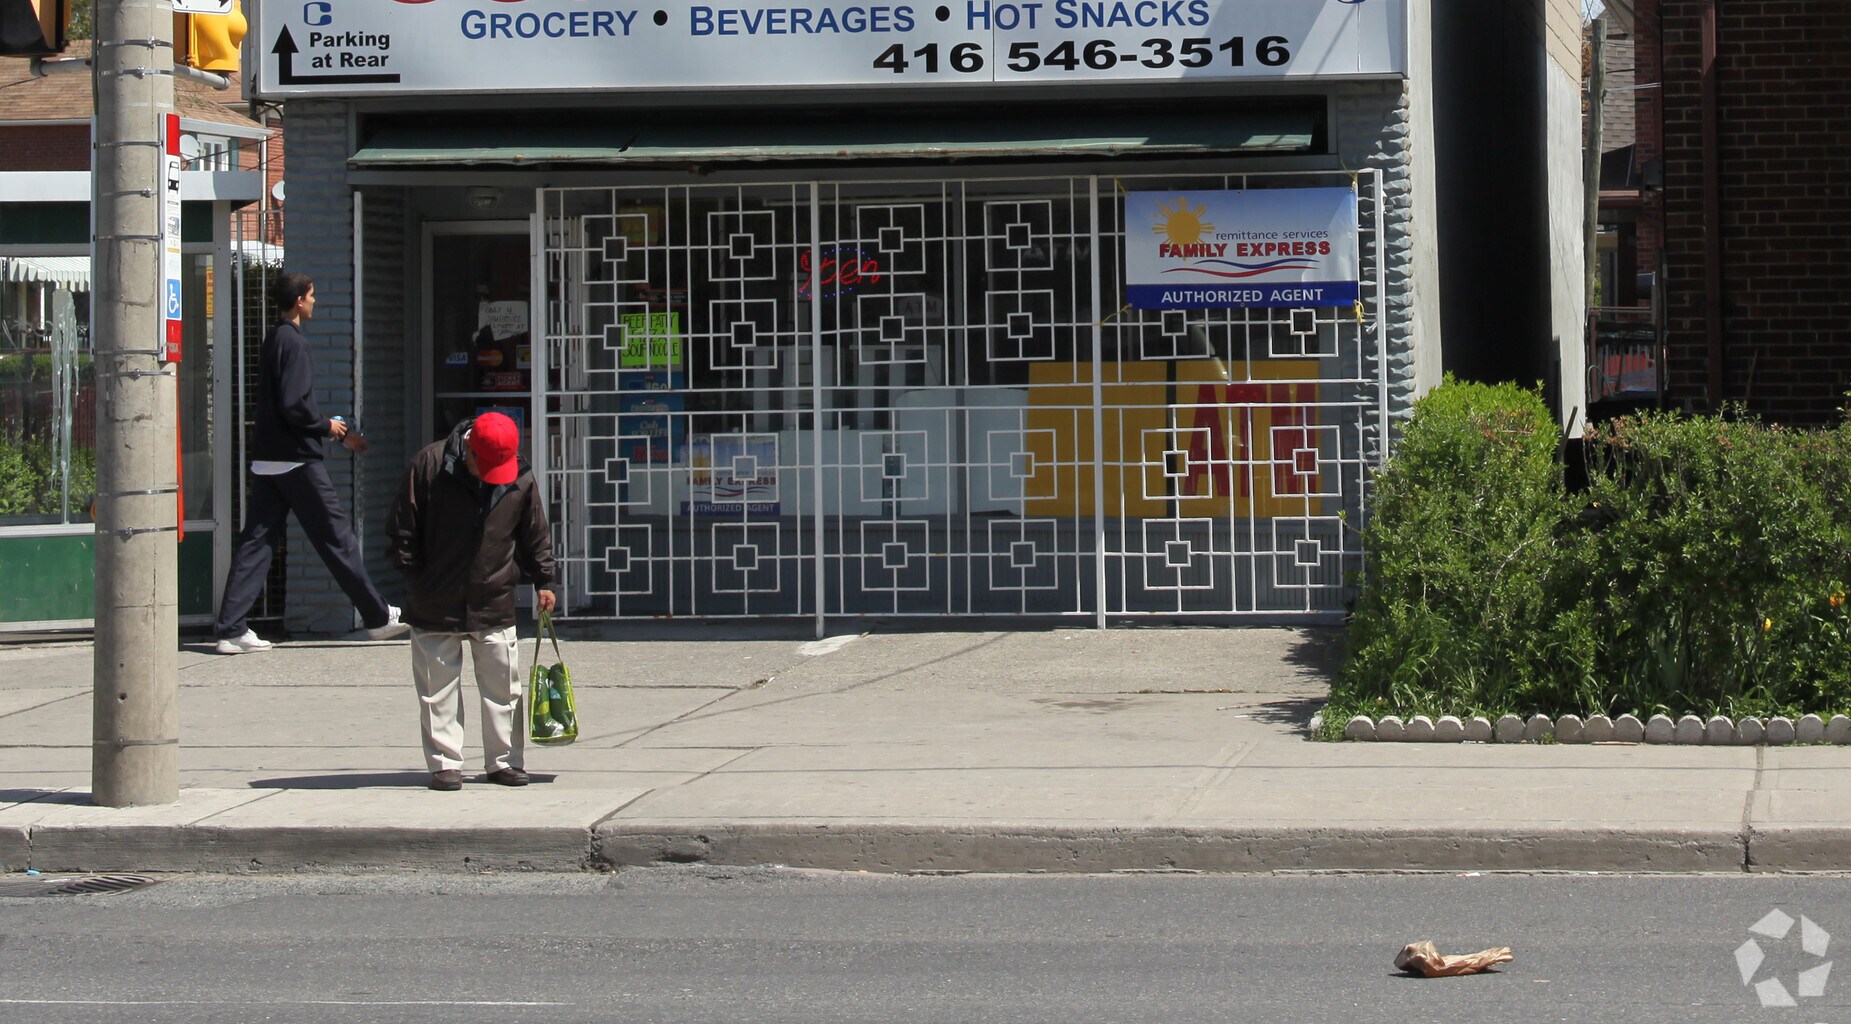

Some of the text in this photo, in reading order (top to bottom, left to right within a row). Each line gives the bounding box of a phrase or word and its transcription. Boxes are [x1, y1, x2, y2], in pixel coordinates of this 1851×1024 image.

[460, 8, 639, 40] GROCERY
[689, 4, 916, 37] BEVERAGES
[966, 0, 1042, 31] HOT
[309, 31, 391, 50] Parking
[311, 51, 389, 68] at Rear
[872, 35, 1291, 75] 416 546-3516
[1216, 228, 1329, 240] remittance services
[1159, 240, 1331, 258] FAMILY EXPRESS
[1161, 288, 1323, 303] AUTHORIZED AGENT
[1183, 383, 1318, 497] ATM
